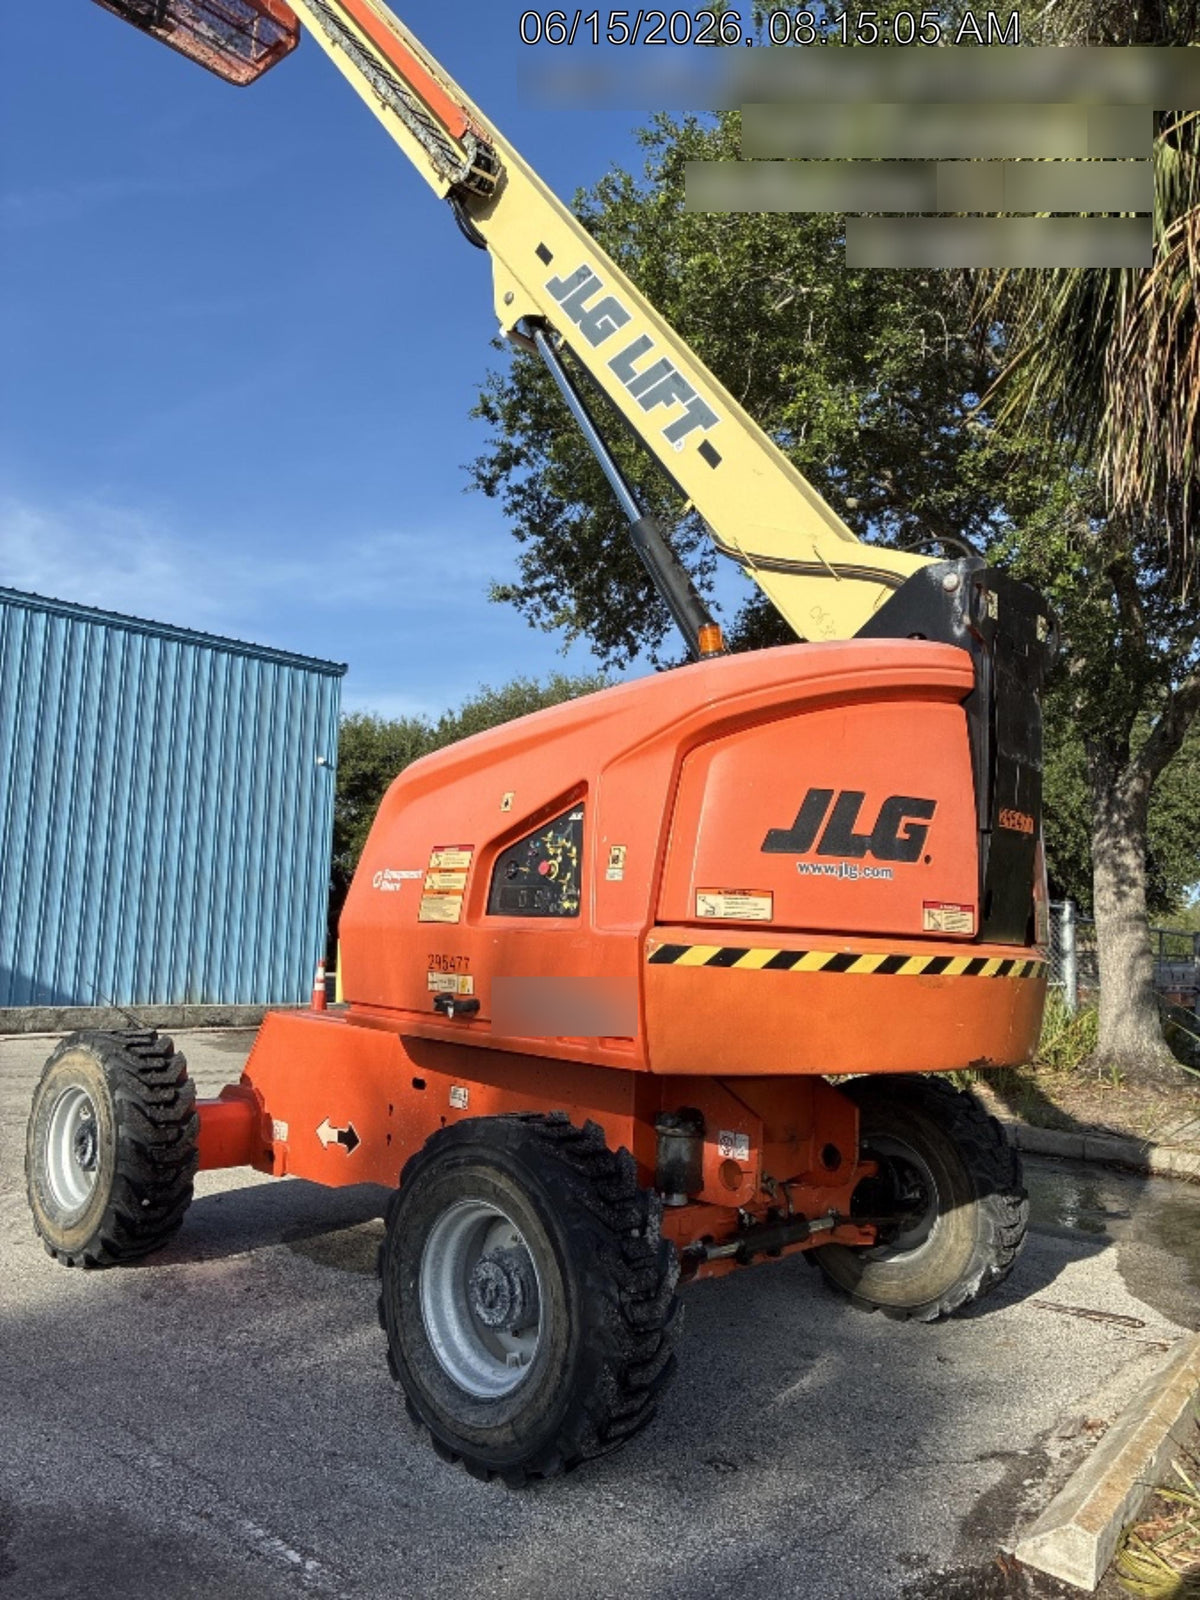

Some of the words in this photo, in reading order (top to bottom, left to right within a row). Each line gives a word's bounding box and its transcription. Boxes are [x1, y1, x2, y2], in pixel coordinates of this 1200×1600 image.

[544, 263, 633, 348] JLG
[606, 333, 721, 444] LIFT
[761, 787, 937, 863] JLG
[796, 861, 893, 881] www.jlg.com
